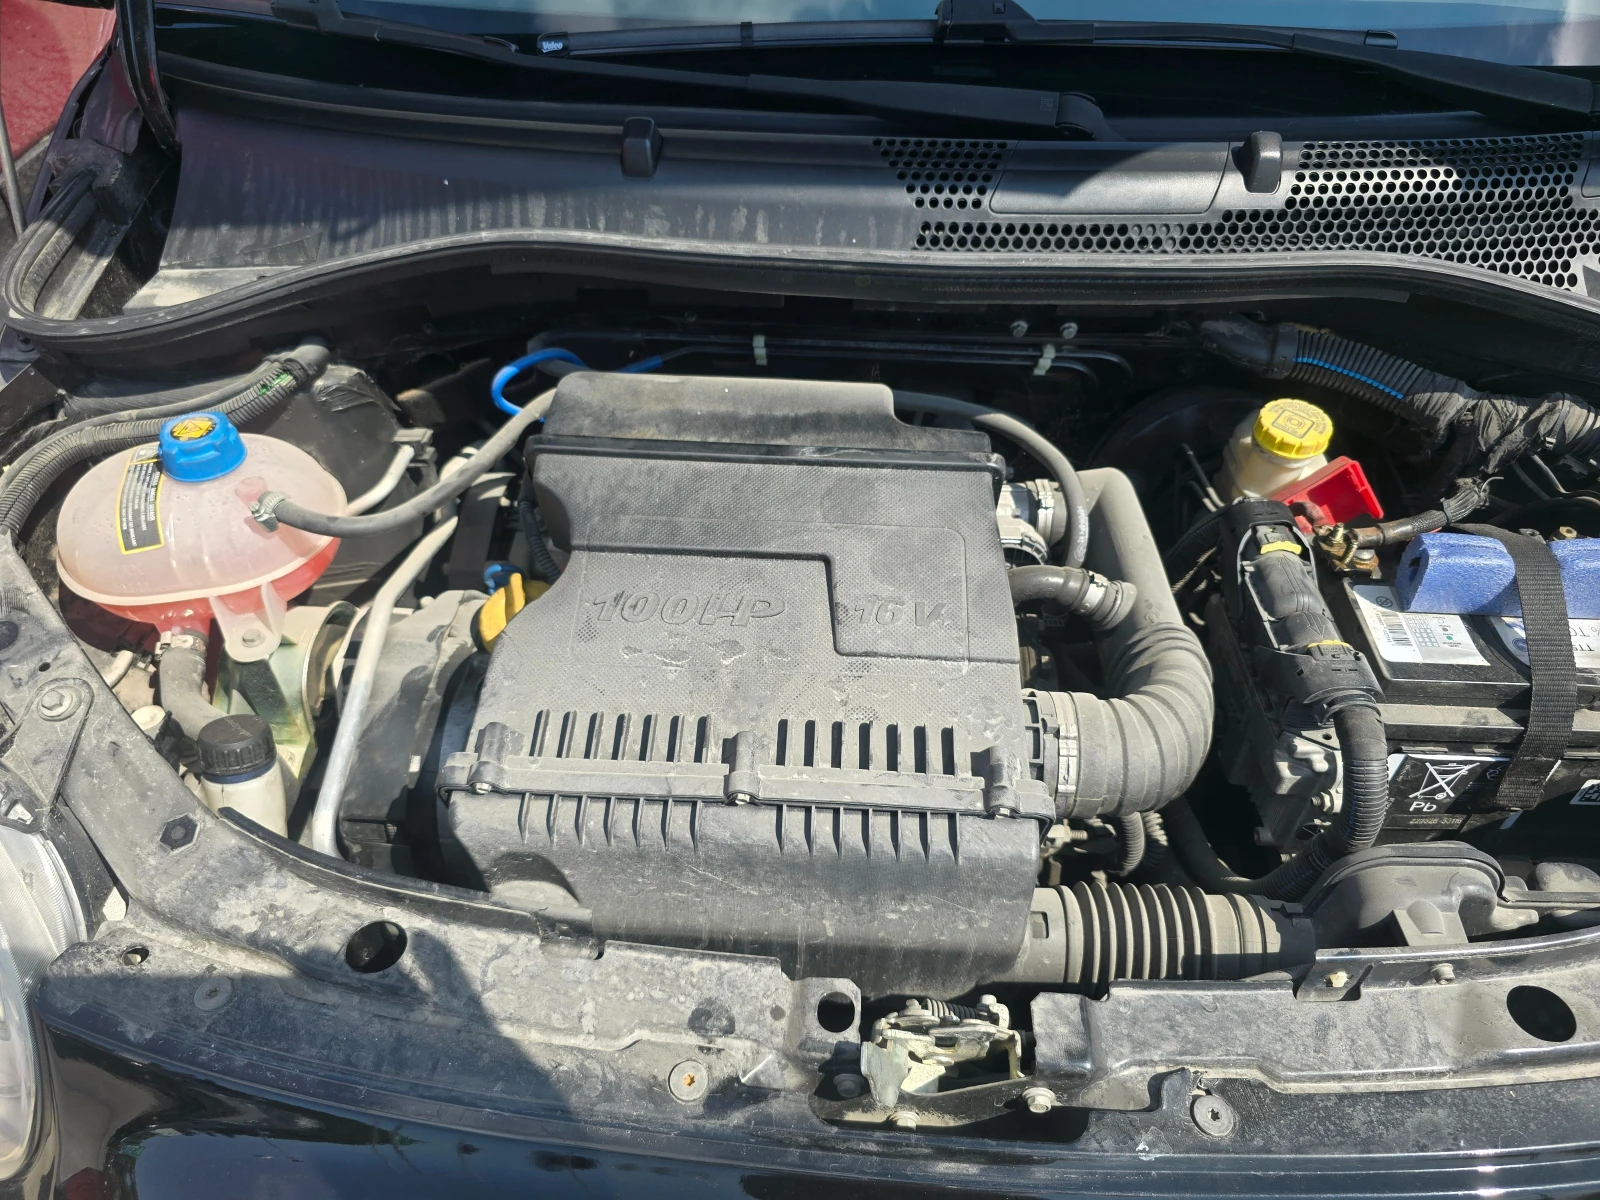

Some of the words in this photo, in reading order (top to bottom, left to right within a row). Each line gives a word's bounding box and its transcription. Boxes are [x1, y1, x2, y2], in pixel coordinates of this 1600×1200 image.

[541, 40, 563, 52] Valeo
[593, 590, 786, 627] 100HP
[1409, 801, 1437, 812] Pb
